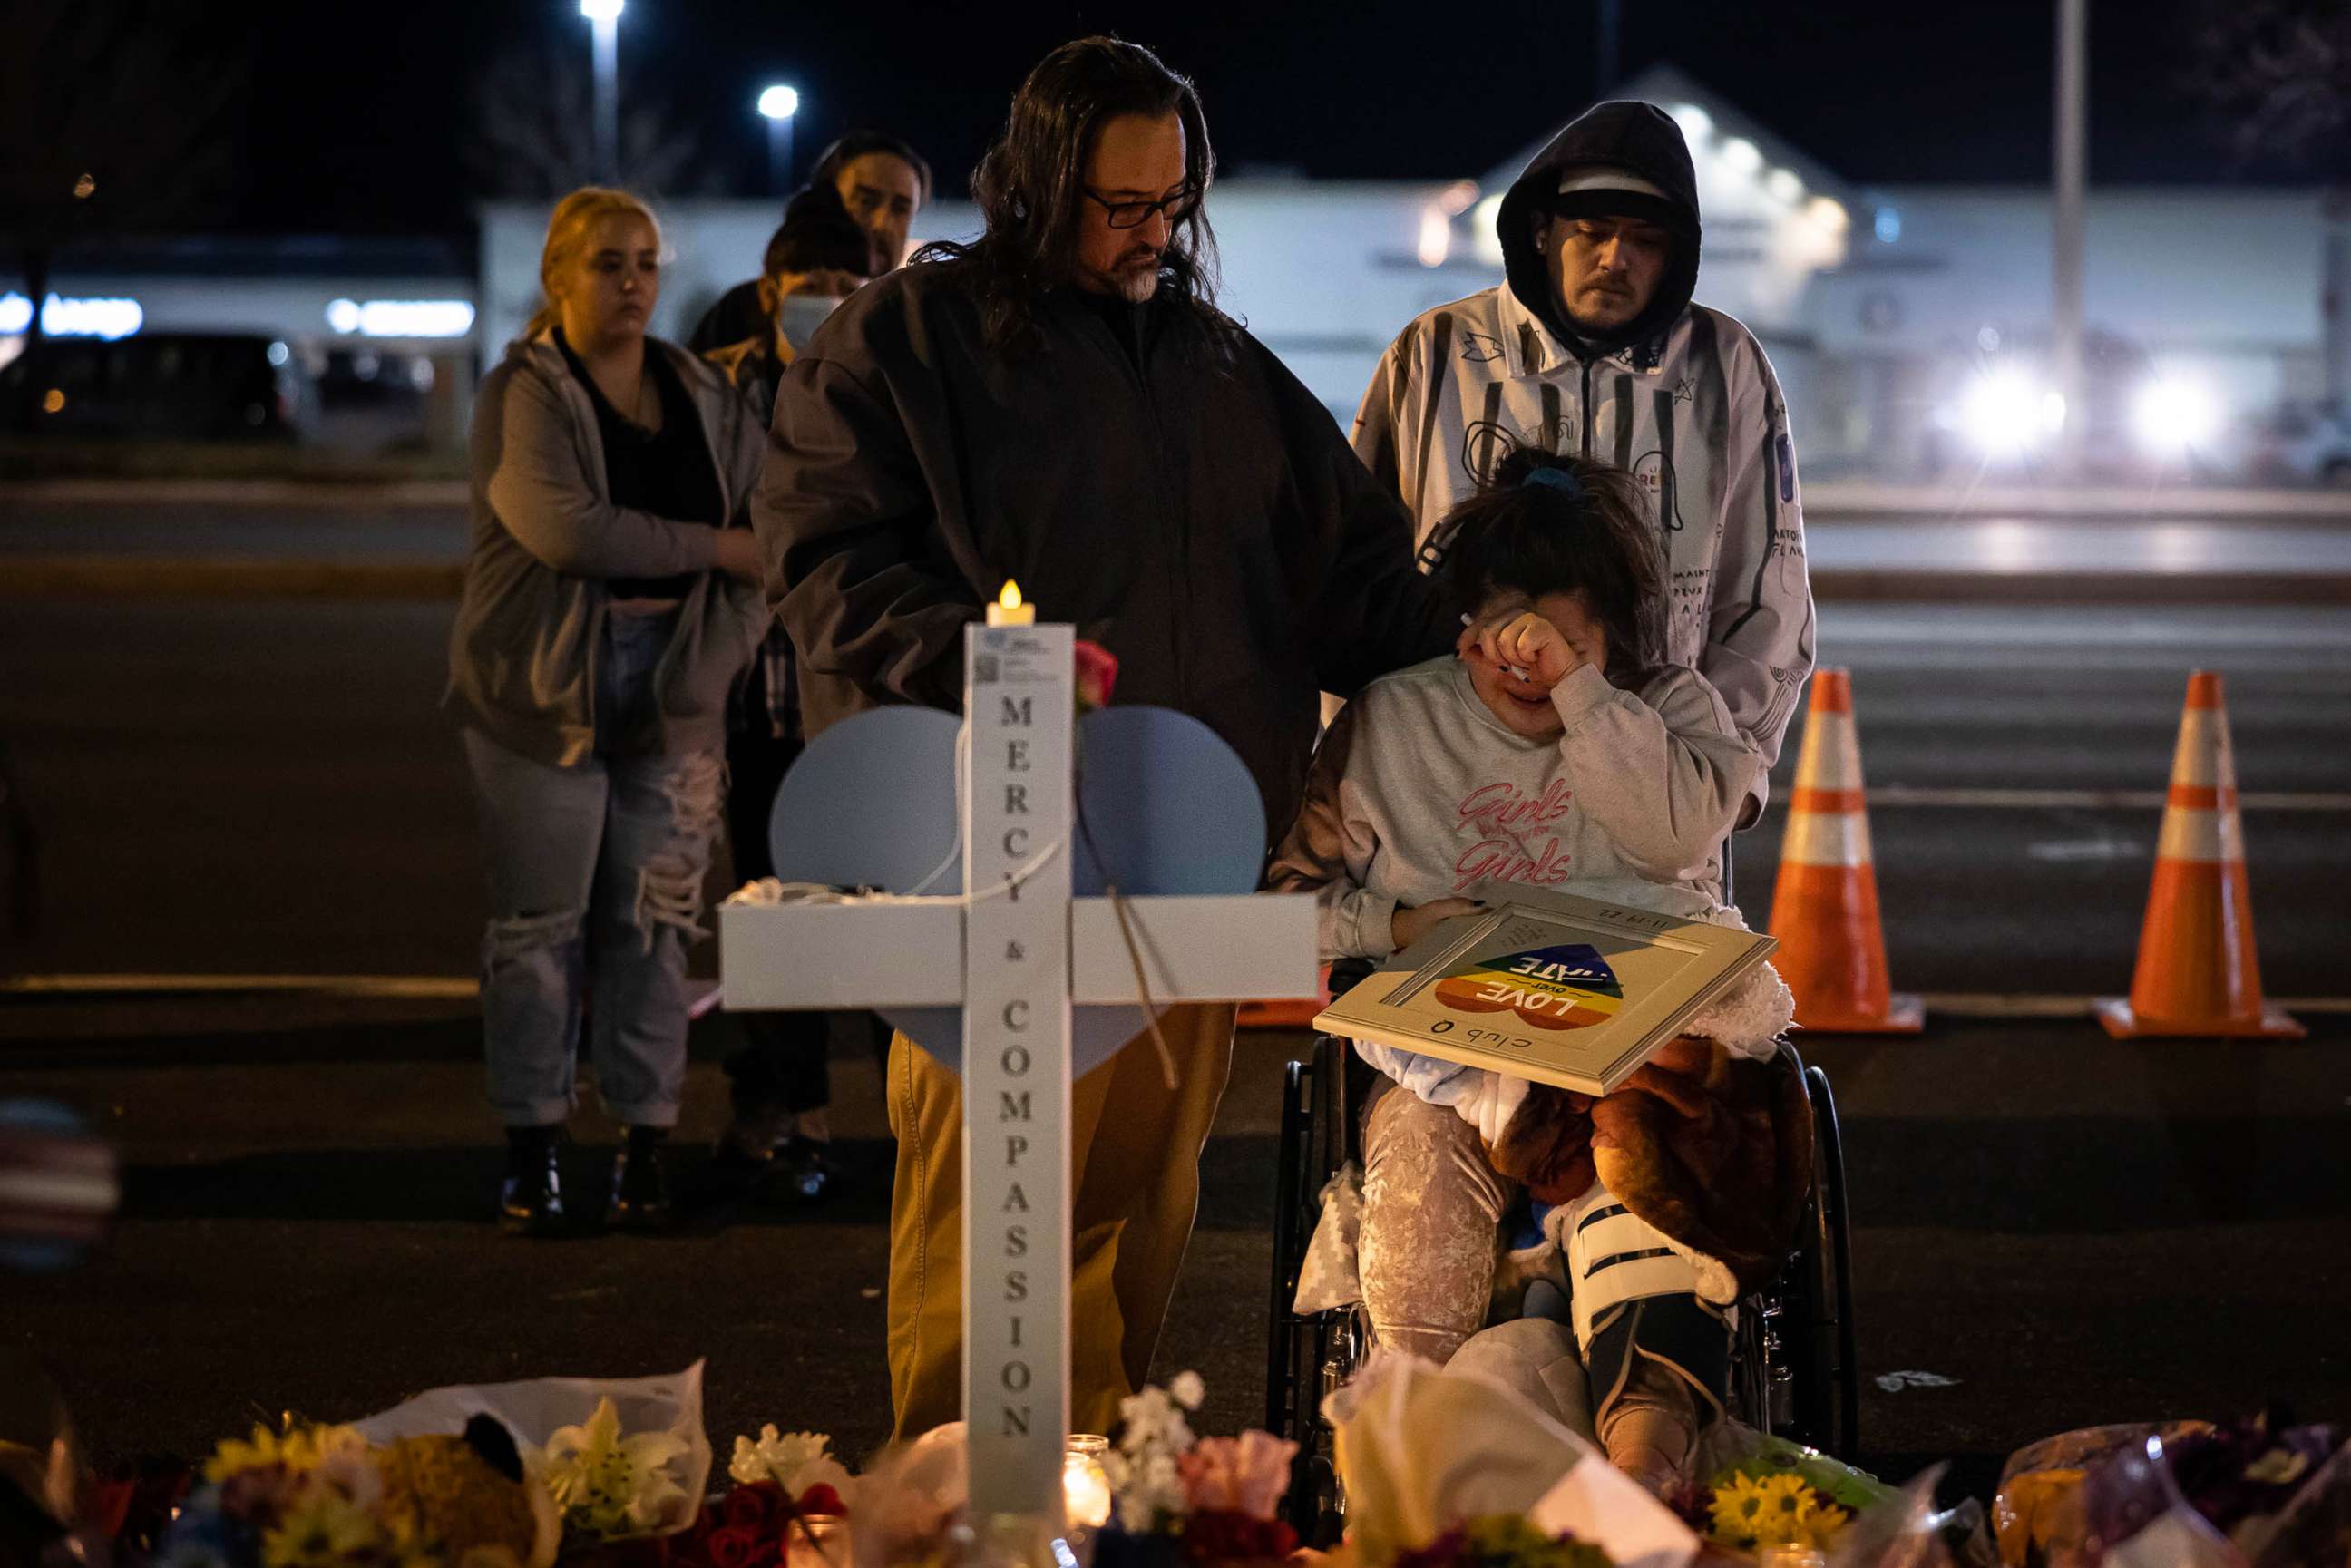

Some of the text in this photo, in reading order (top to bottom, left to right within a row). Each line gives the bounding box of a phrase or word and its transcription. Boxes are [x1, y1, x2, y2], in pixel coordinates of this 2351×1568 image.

[1000, 696, 1033, 901] MERCY
[1455, 778, 1572, 831] Girls
[1453, 837, 1572, 891] Girls
[1006, 940, 1025, 961] &
[1475, 980, 1579, 1017] LOVE
[999, 999, 1031, 1438] COMPASSION
